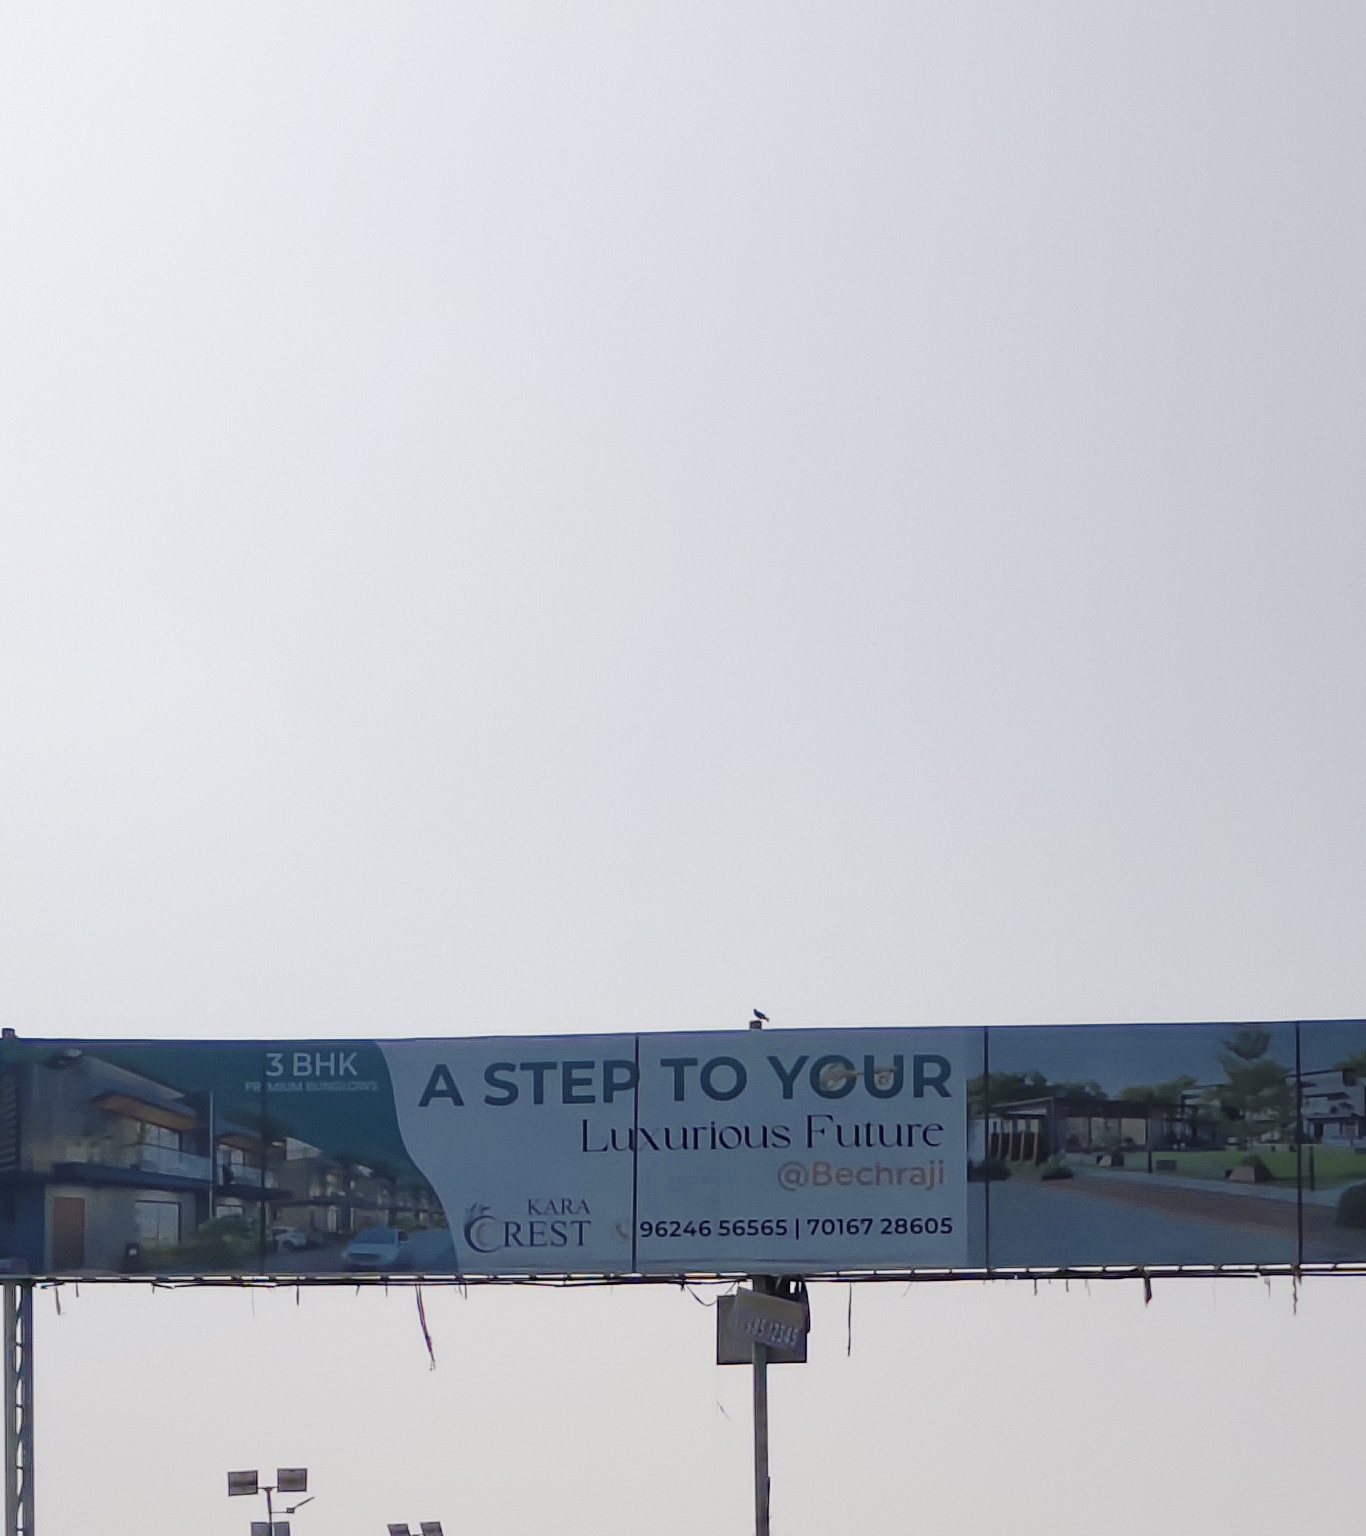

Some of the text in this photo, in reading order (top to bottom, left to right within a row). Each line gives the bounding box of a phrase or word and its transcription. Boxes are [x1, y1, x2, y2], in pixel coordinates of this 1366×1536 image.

[266, 1052, 358, 1077] 3 BHK
[245, 1082, 303, 1092] PRMIUM
[418, 1054, 952, 1108] A STEP TO YOUR
[582, 1114, 944, 1153] Luxurious Future
[777, 1160, 945, 1192] @Bechraji
[528, 1198, 591, 1216] KARA
[464, 1214, 592, 1253] CREST
[639, 1219, 712, 1238] 96246
[717, 1218, 788, 1237] 56565
[807, 1217, 874, 1236] 70167
[880, 1216, 953, 1235] 28605
